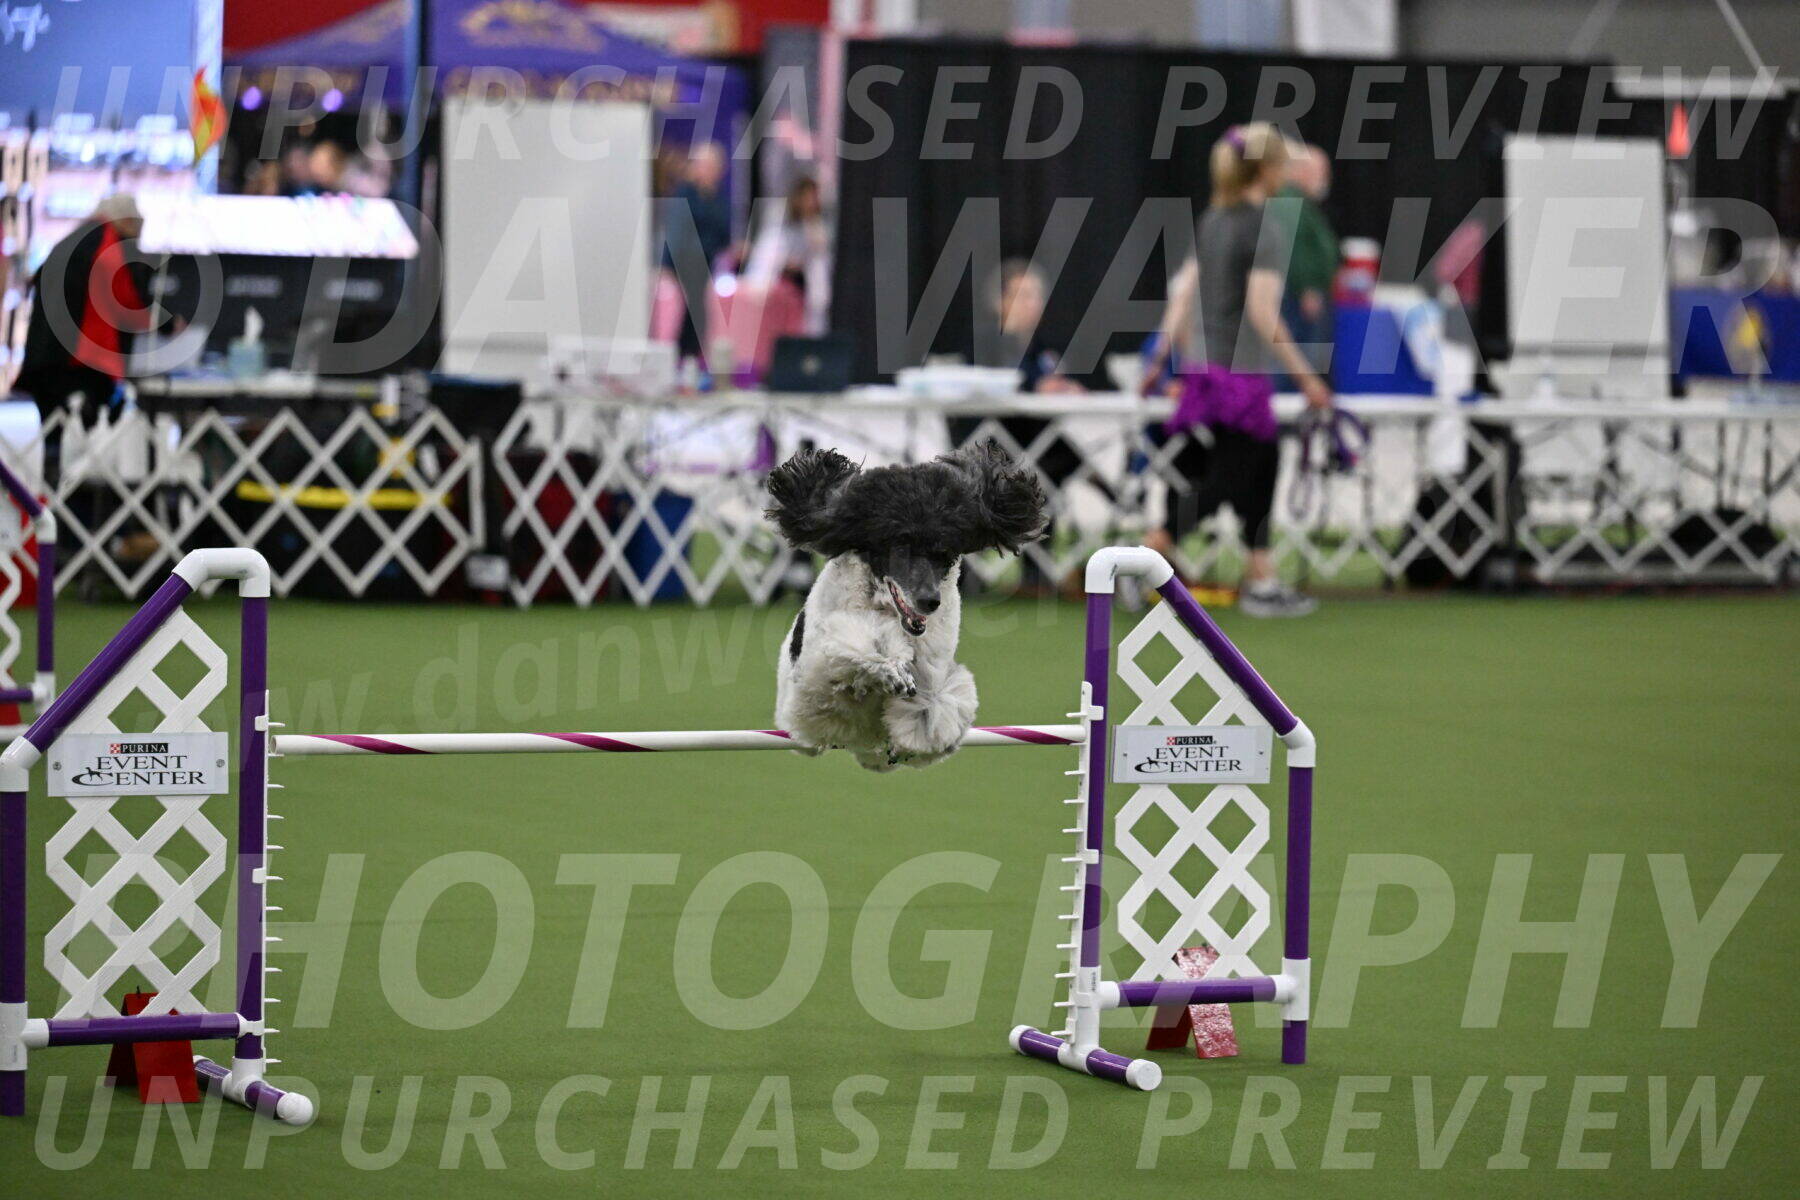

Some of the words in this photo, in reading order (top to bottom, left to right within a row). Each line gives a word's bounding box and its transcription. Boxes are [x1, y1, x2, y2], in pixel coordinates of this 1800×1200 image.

[1176, 736, 1213, 745] PURINA
[121, 743, 167, 753] PURINA
[1155, 746, 1229, 760] EVENT
[96, 755, 188, 770] EVENT
[1134, 759, 1243, 774] CENTER
[72, 769, 207, 786] CENTER
